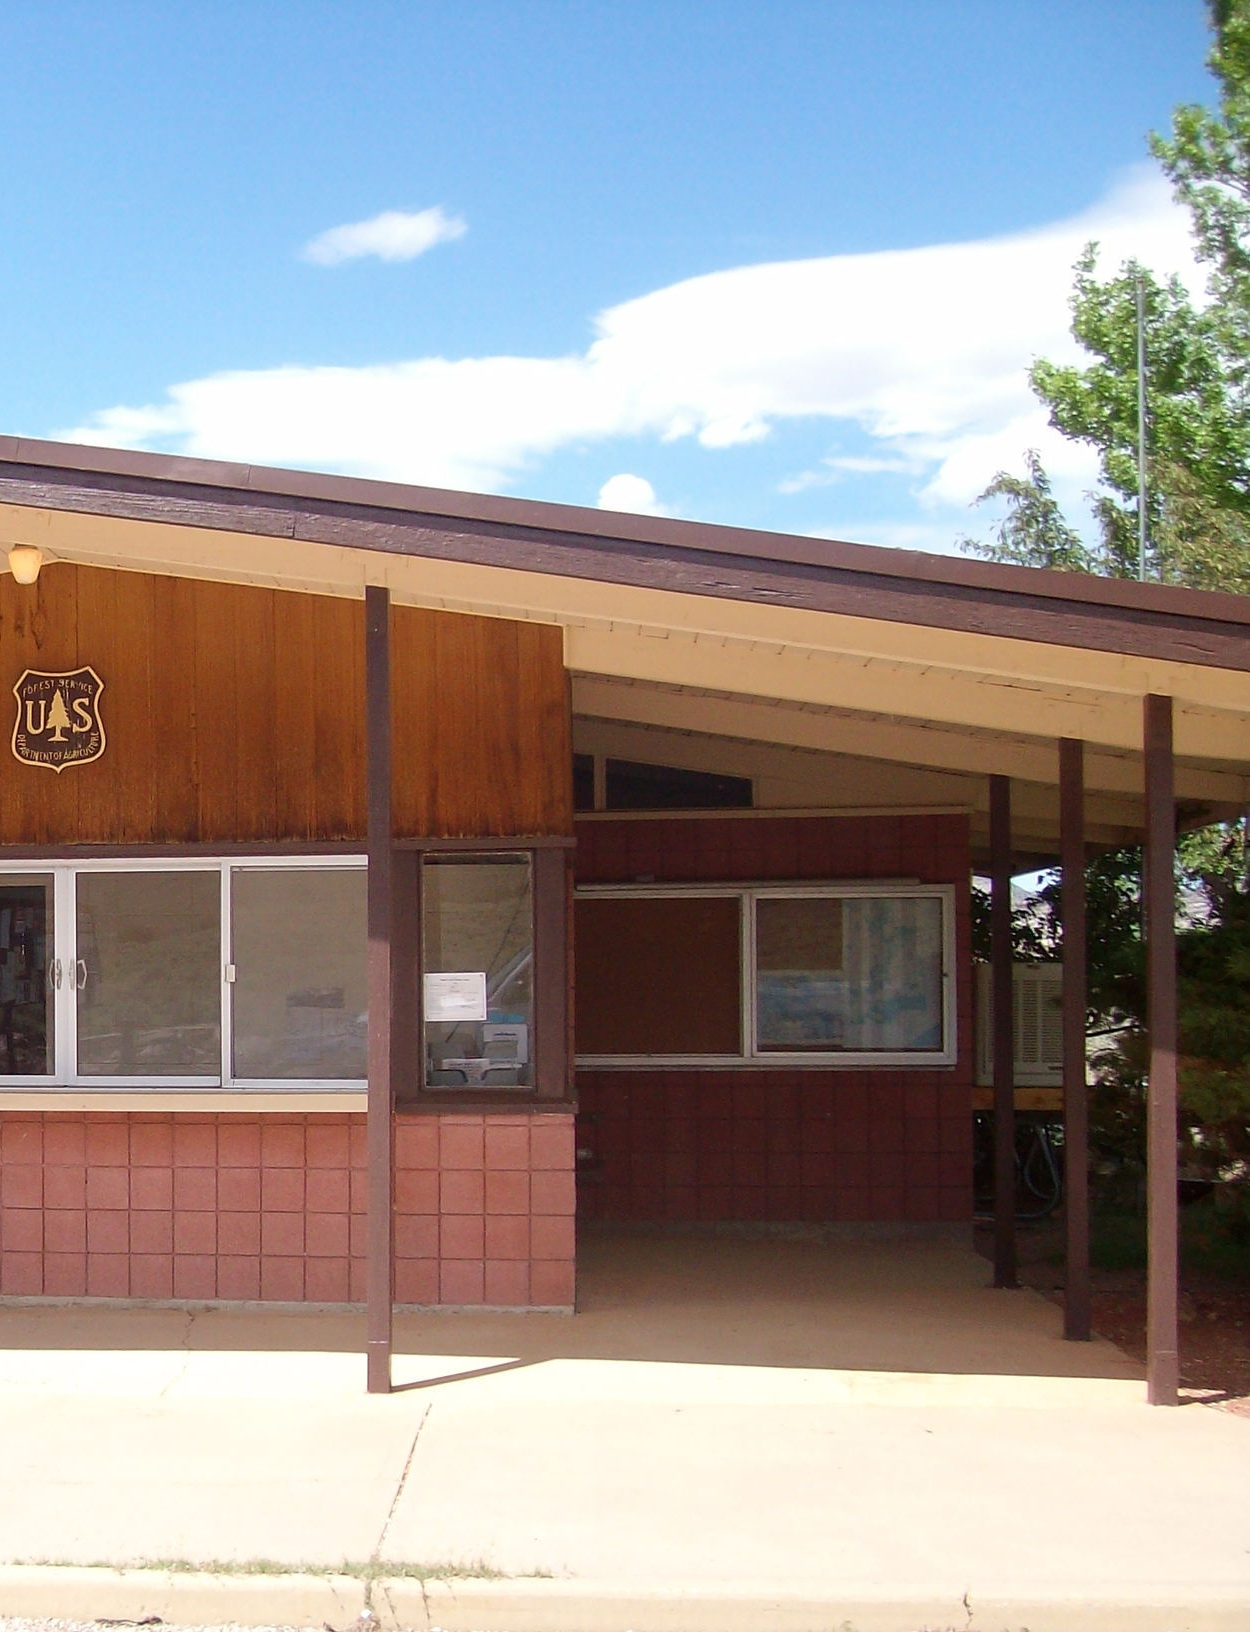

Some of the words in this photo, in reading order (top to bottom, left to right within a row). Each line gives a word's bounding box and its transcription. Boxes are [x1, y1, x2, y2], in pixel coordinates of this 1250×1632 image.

[23, 679, 55, 697] FOREST
[58, 679, 93, 694] SERVICE
[25, 700, 46, 735] U
[72, 698, 93, 733] S
